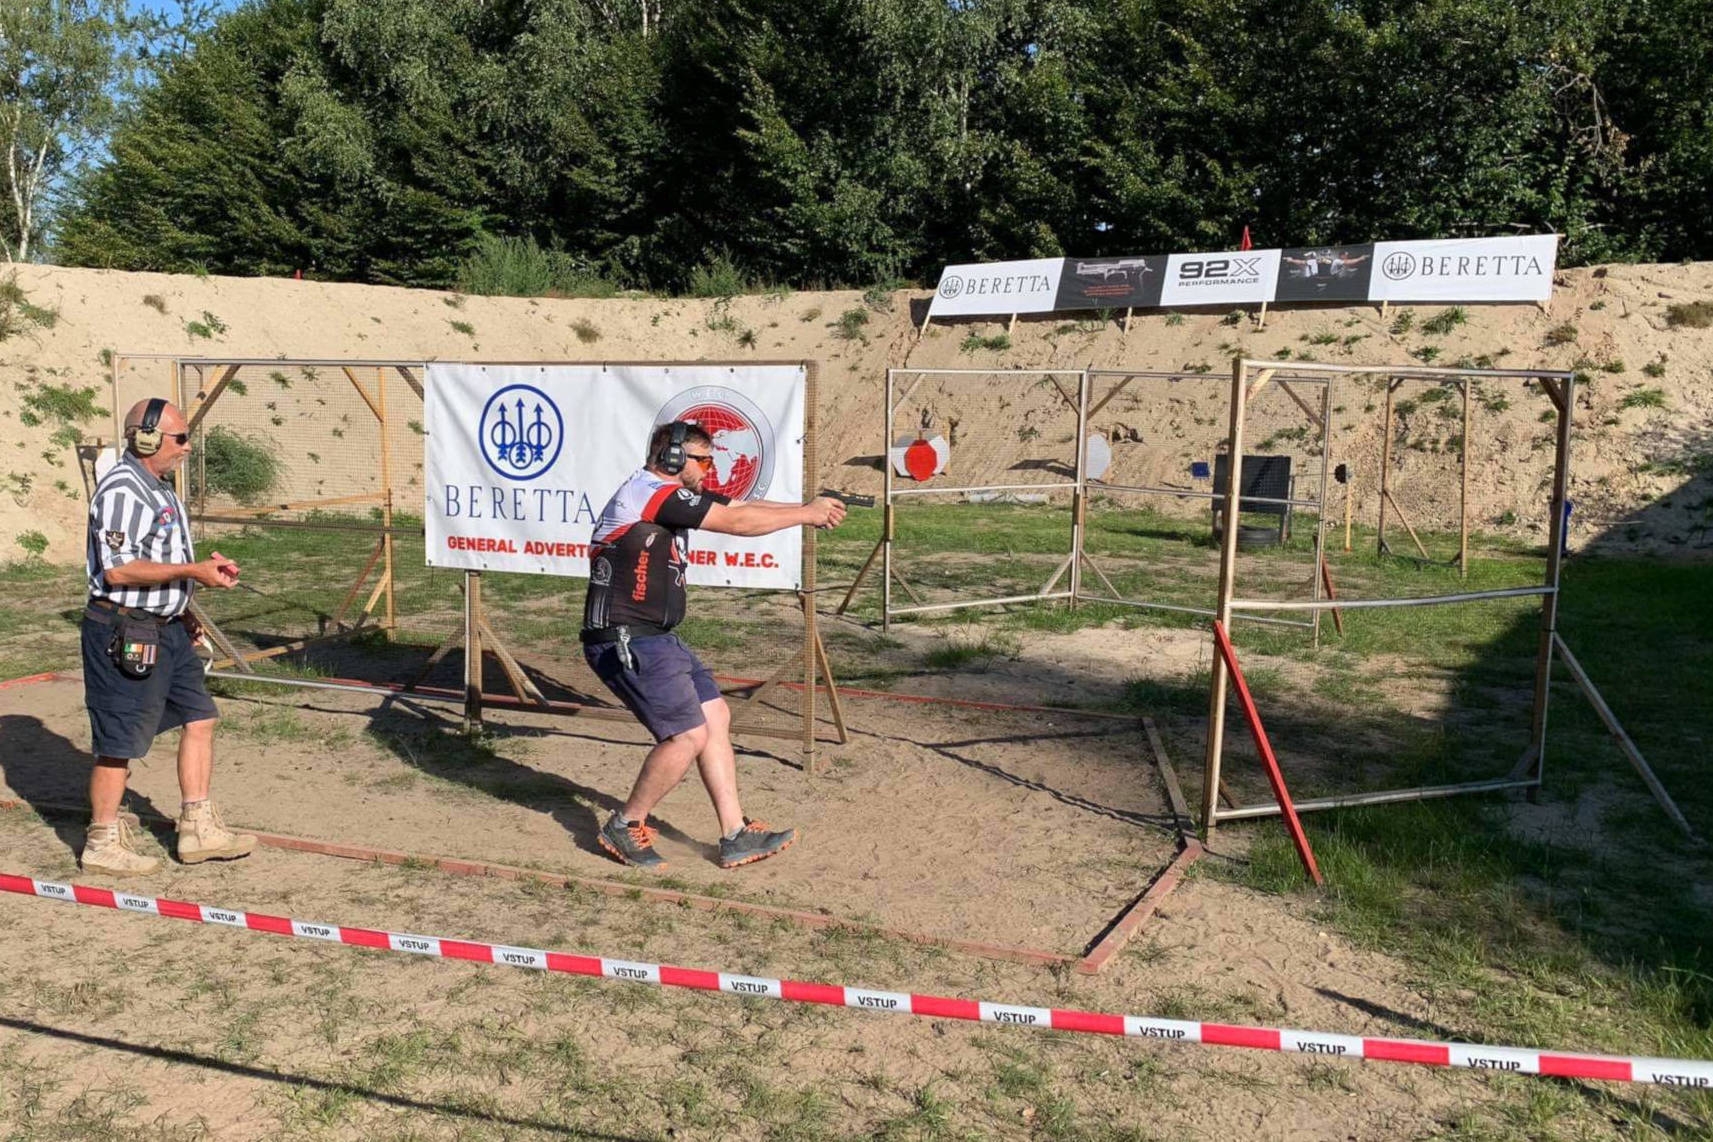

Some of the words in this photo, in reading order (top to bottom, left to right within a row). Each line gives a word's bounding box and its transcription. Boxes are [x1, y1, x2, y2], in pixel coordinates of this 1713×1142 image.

[1179, 257, 1262, 279] 92X
[1421, 255, 1543, 276] BERETTA
[966, 275, 1051, 295] BERETTA
[1178, 277, 1260, 287] PERFORMANCE
[445, 485, 597, 524] BERETTA
[447, 536, 518, 554] GENERAL
[724, 552, 779, 568] W.E.C.
[632, 550, 650, 601] fischer
[41, 883, 66, 895] VSTUP
[123, 897, 149, 909] VSTUP
[209, 911, 237, 922] VSTUP
[301, 926, 330, 937] VSTUP
[398, 939, 430, 950] VSTUP
[503, 952, 535, 965] VSTUP
[613, 967, 648, 979] VSTUP
[731, 981, 768, 994] VSTUP
[857, 996, 897, 1009] VSTUP
[994, 1010, 1036, 1025] VSTUP
[1139, 1026, 1186, 1039] VSTUP
[1296, 1040, 1346, 1055] VSTUP
[1467, 1056, 1521, 1072] VSTUP
[1652, 1074, 1709, 1087] VSTUP
